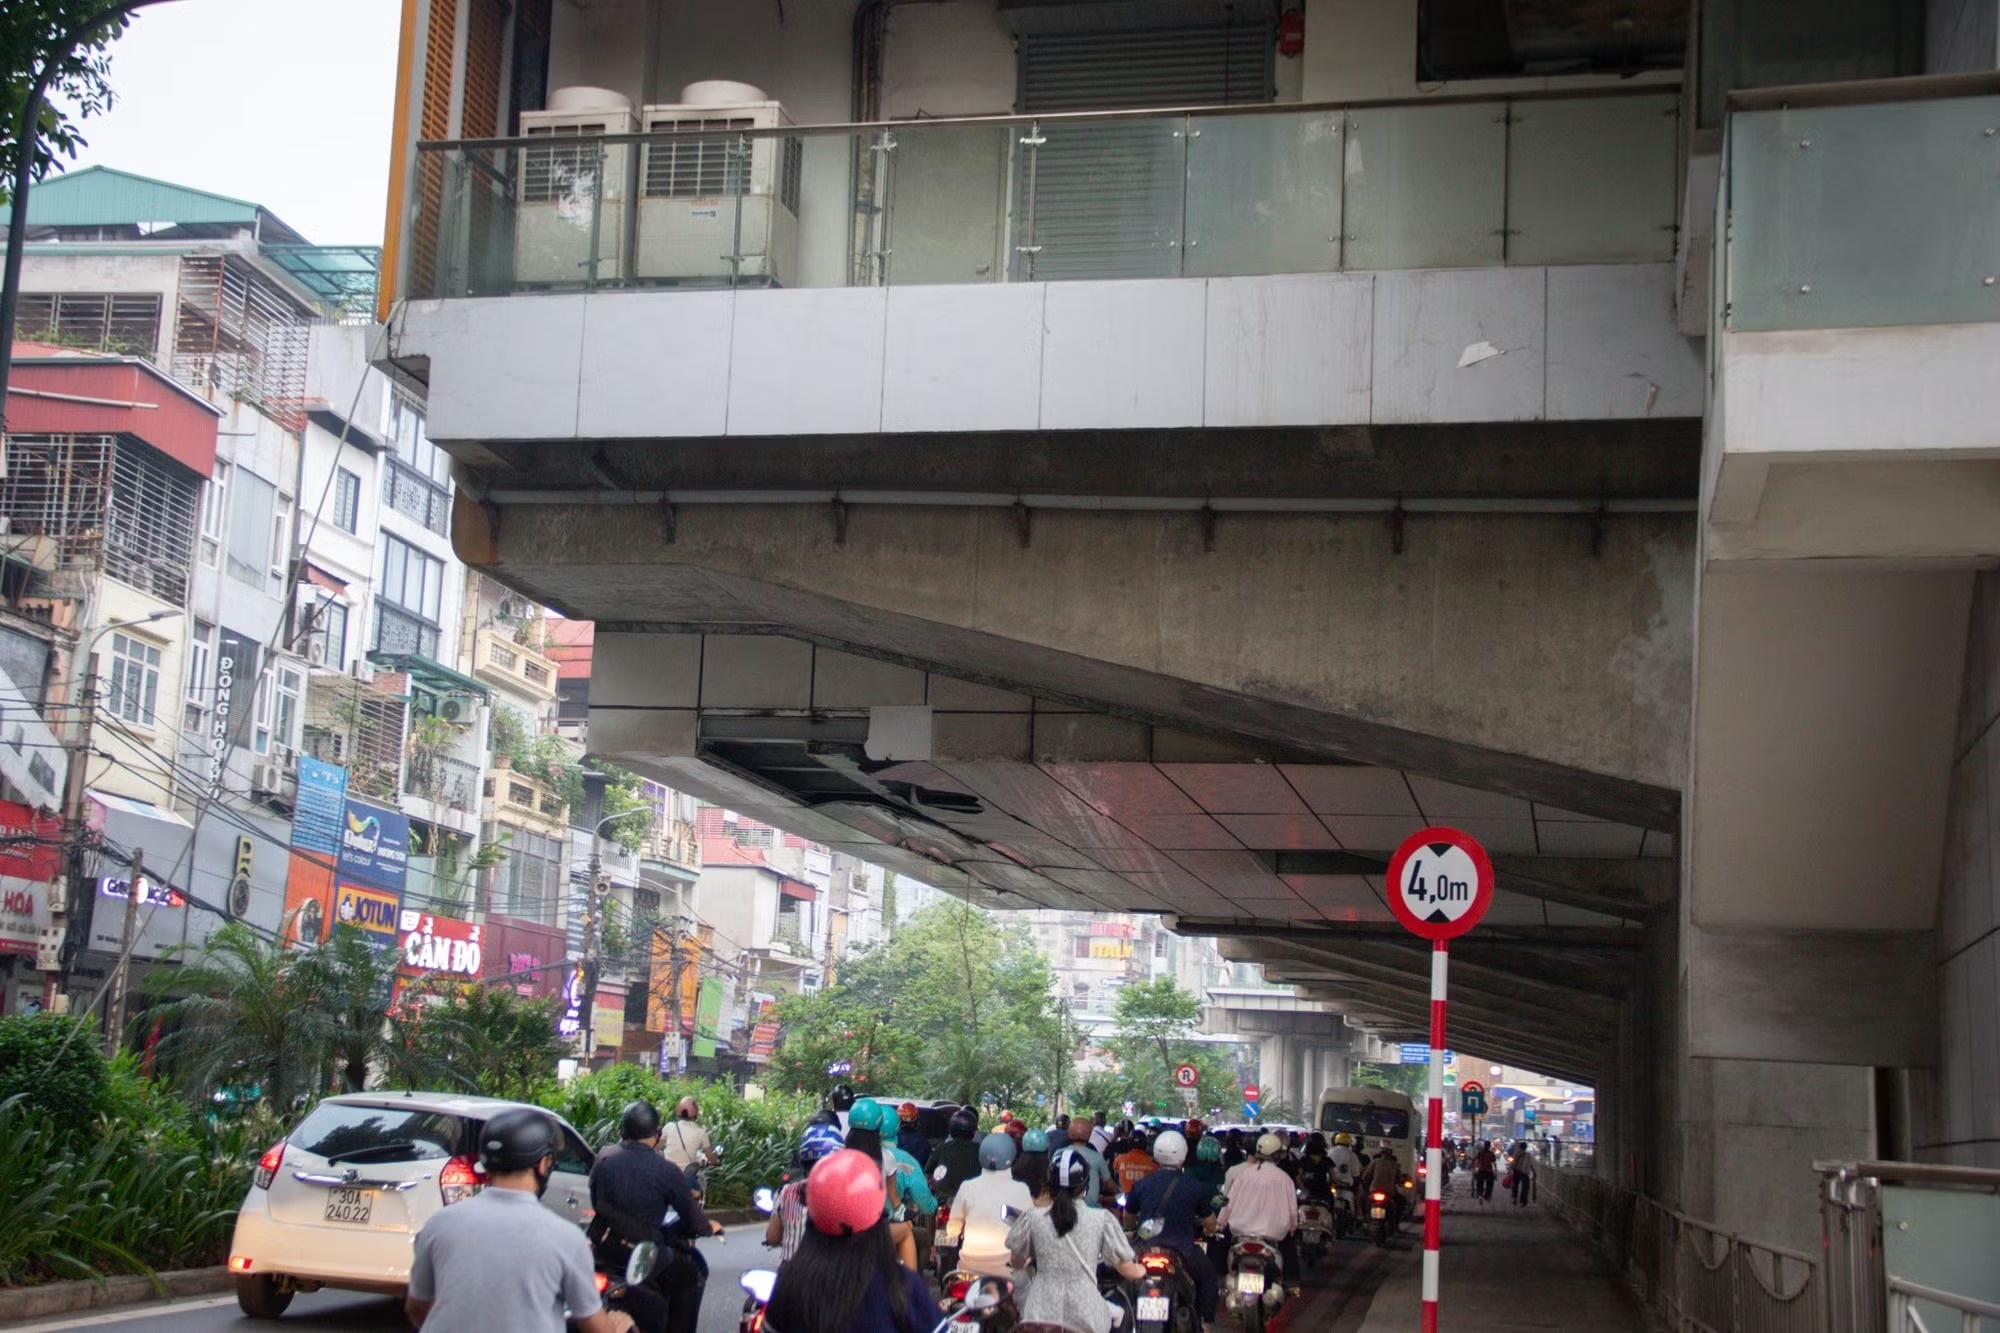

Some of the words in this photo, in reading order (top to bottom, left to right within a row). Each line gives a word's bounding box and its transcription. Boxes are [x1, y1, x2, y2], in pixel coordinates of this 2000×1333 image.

[1408, 860, 1468, 904] 4,0m
[352, 895, 396, 929] JOTUN
[338, 1189, 362, 1205] 30A
